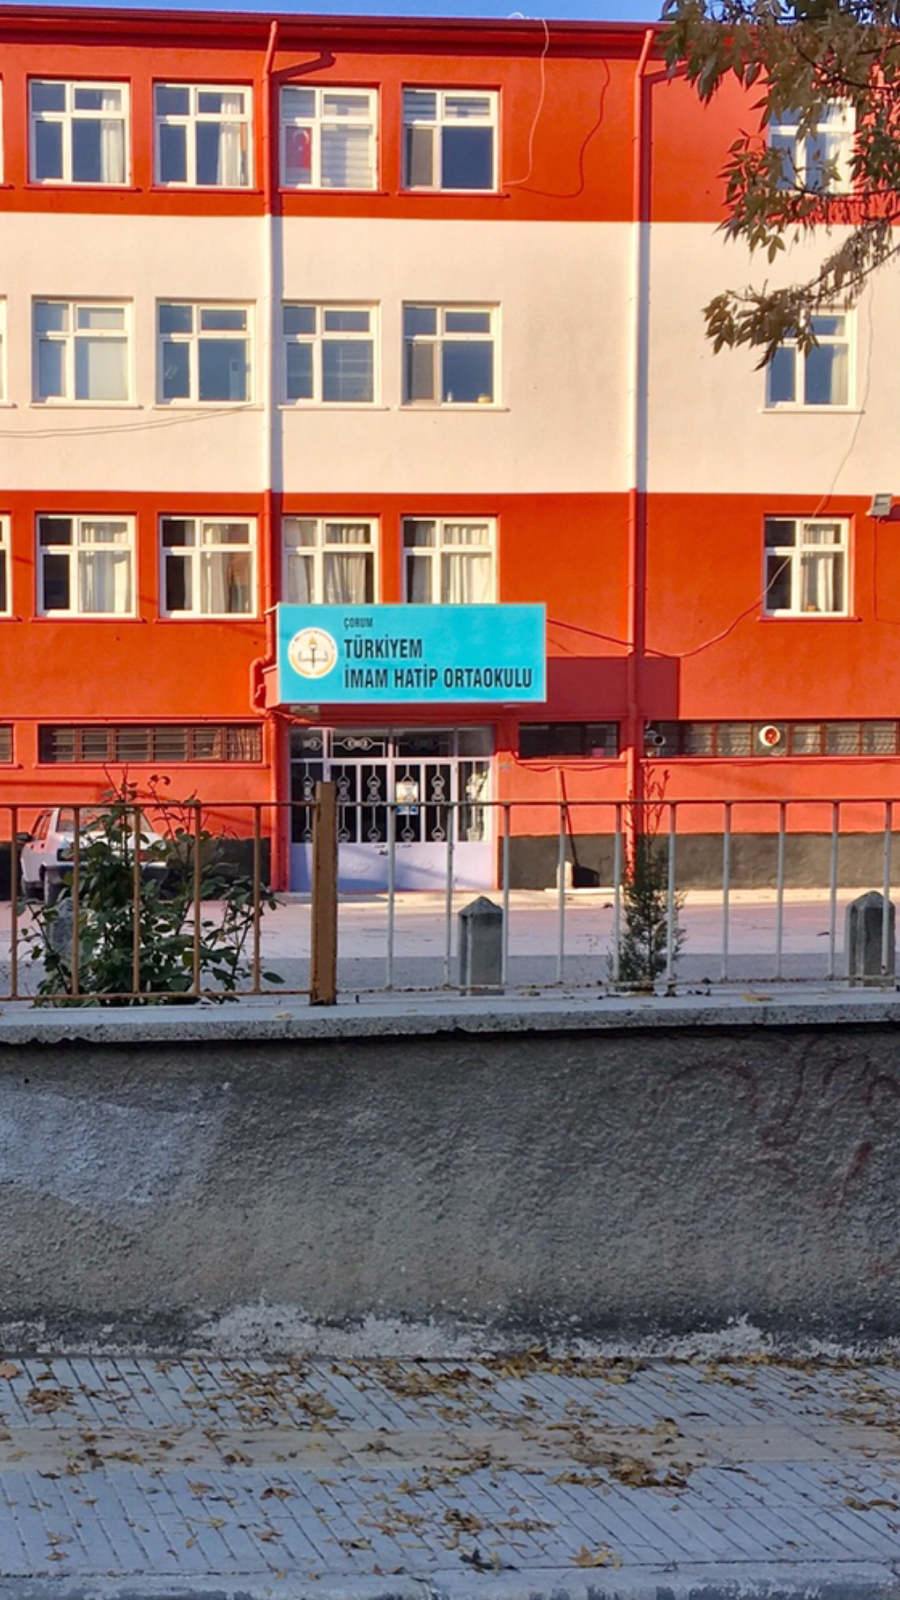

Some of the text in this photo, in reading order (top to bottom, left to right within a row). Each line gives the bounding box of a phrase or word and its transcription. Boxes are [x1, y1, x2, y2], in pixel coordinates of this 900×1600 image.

[343, 634, 423, 659] TÜRKİYEM
[344, 664, 533, 689] İMAM HATİP ORTAOKULU
